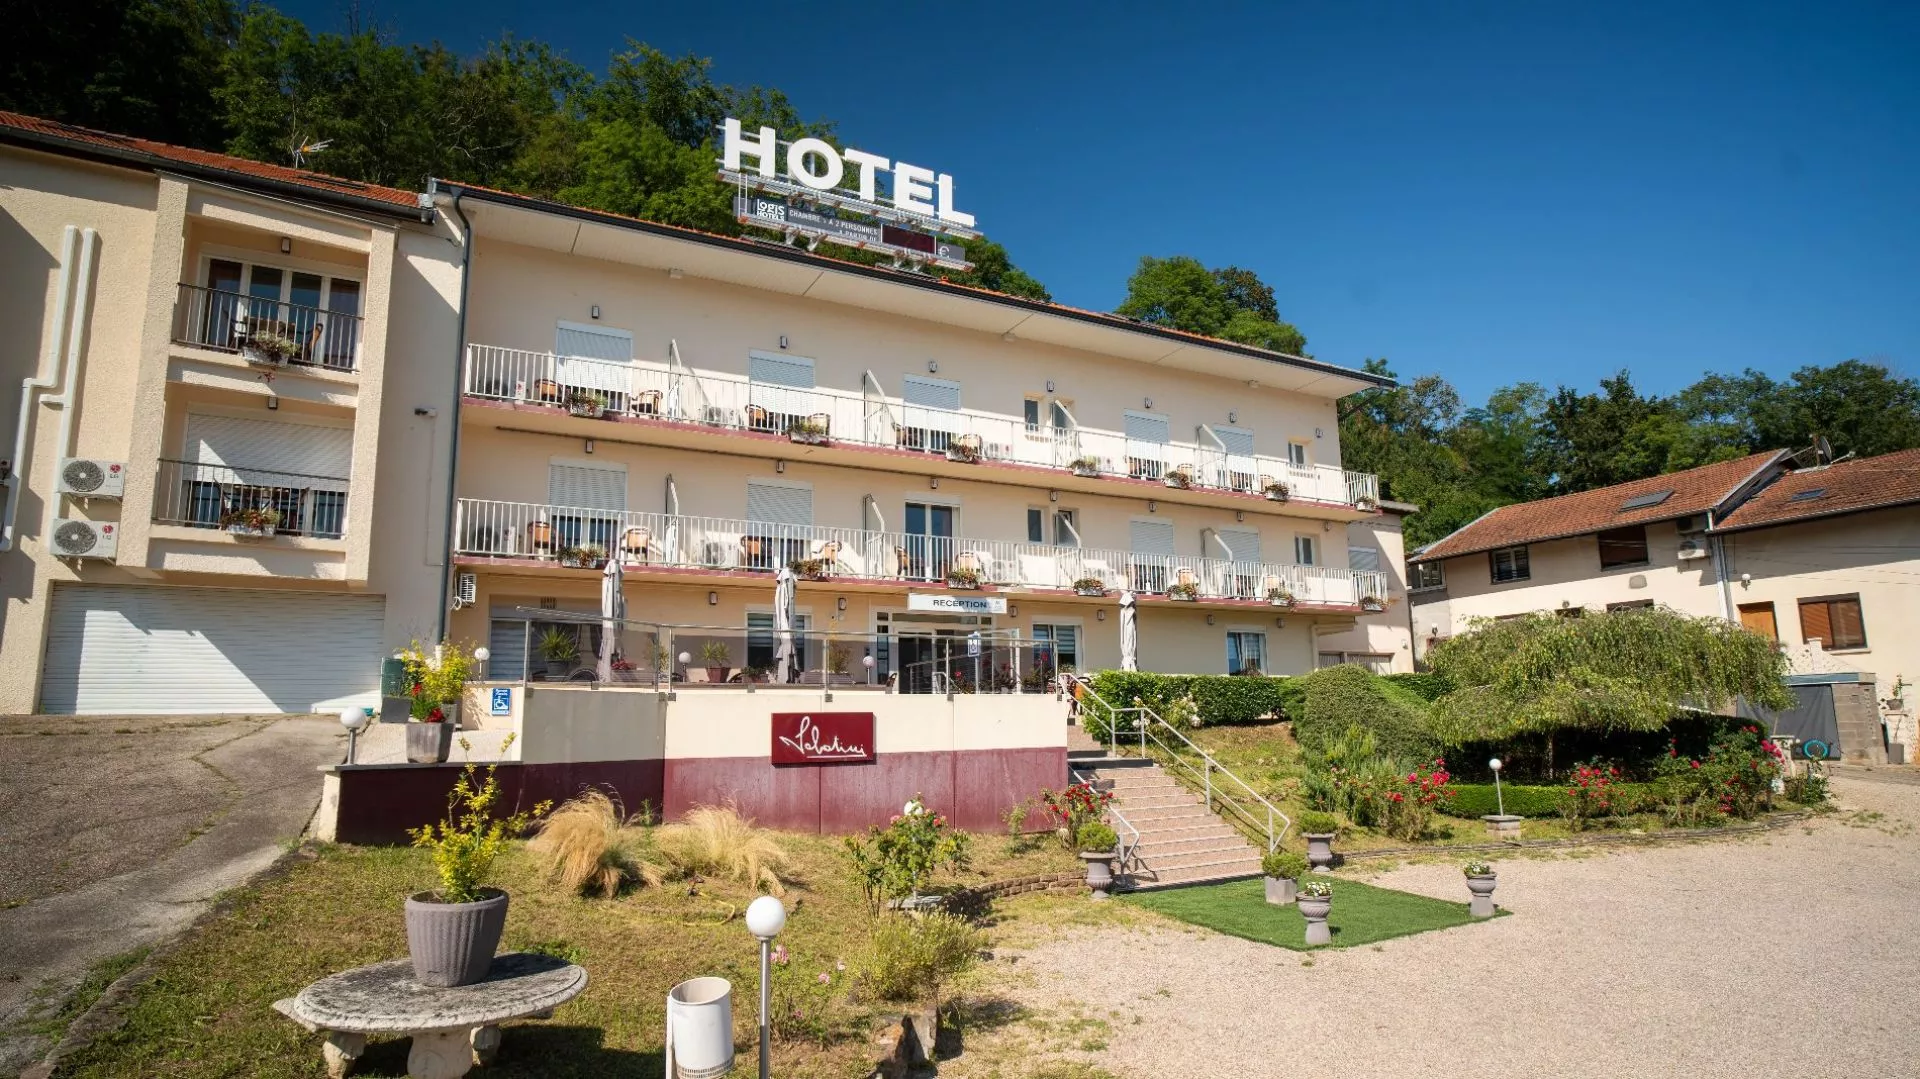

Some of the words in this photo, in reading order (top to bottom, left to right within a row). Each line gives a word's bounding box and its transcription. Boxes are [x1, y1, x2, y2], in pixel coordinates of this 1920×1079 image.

[724, 117, 975, 227] HOTEL
[756, 210, 785, 222] HOTELS
[789, 209, 821, 223] CHAMBRE
[841, 221, 878, 235] PERSONNES
[932, 599, 987, 609] RECEPTION
